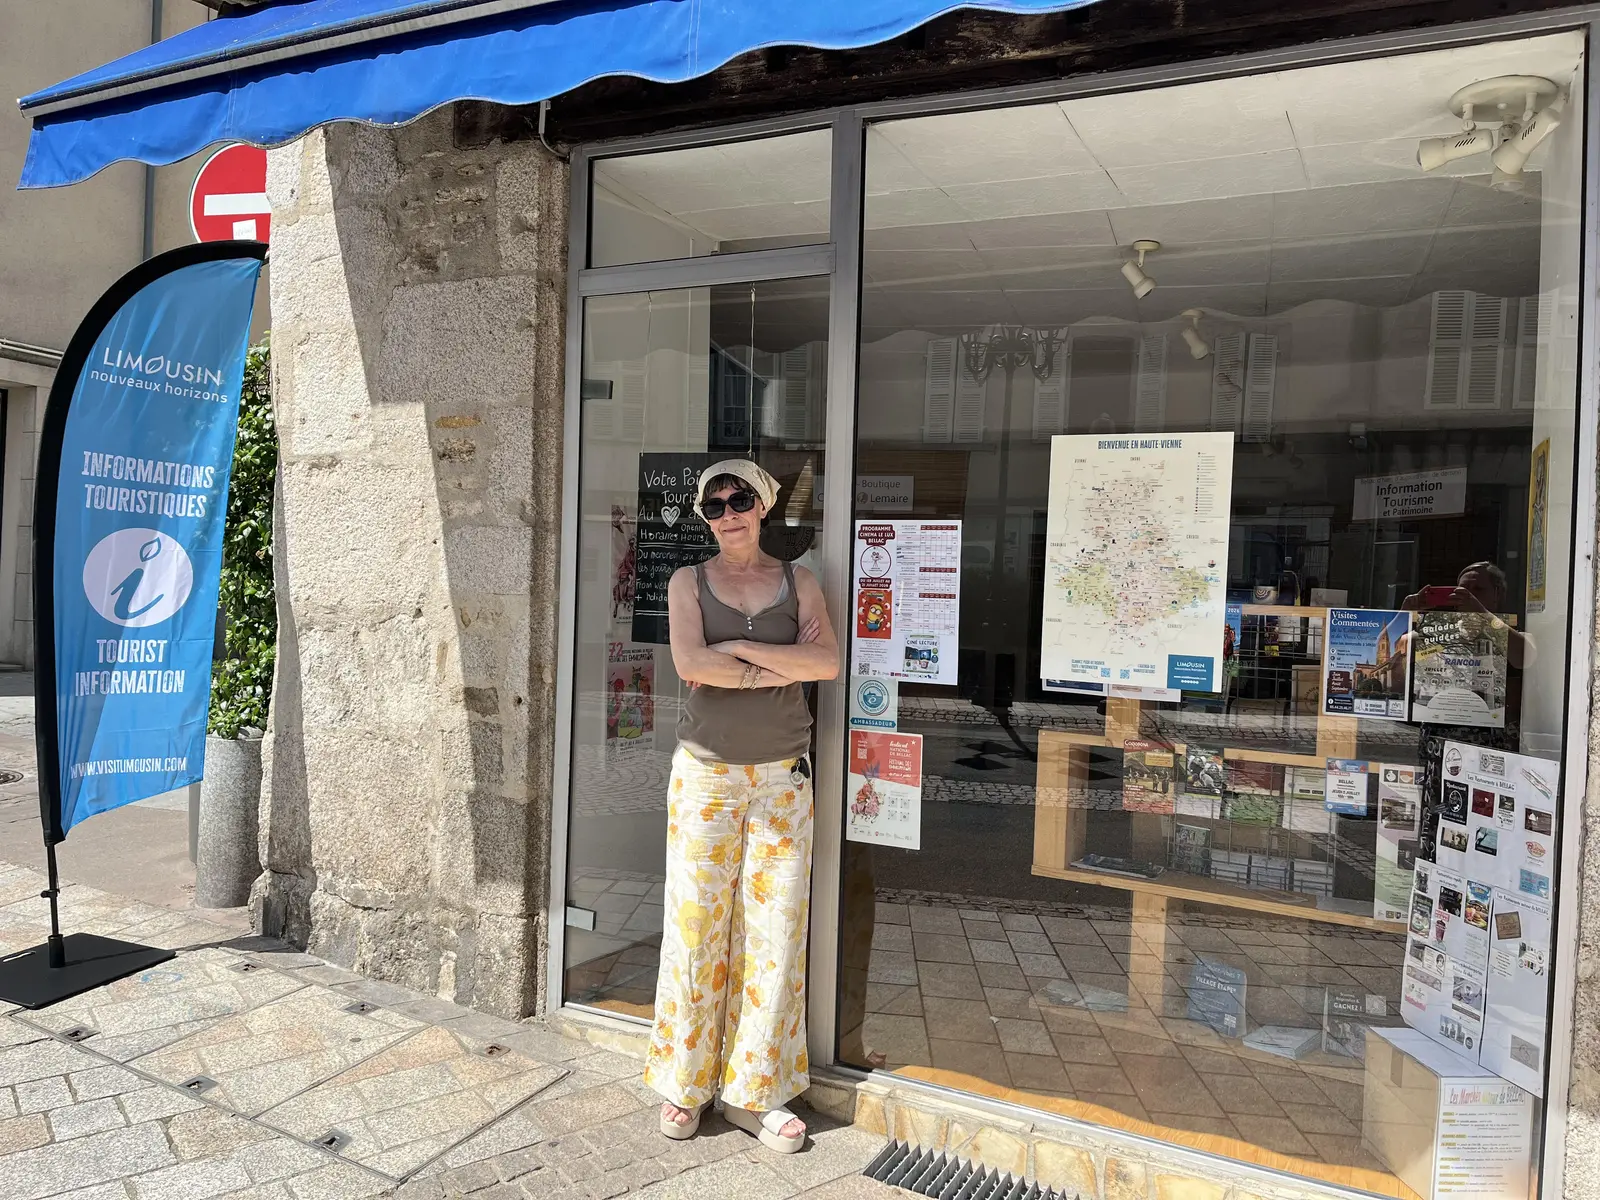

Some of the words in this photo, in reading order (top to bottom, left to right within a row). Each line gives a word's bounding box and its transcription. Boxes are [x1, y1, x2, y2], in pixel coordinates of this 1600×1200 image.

[103, 347, 222, 387] LIMOUSIN
[91, 370, 161, 392] nouveaux
[165, 382, 228, 403] horizons
[1098, 440, 1130, 449] BIENVENUE
[1131, 440, 1139, 449] EN
[1140, 439, 1182, 449] HAUTE-VIENNE
[81, 450, 215, 488] INFORMATIONS
[643, 469, 677, 488] Votre
[862, 480, 901, 492] Boutique
[1376, 481, 1443, 496] Information
[84, 484, 207, 518] TOURISTIQUES
[870, 494, 909, 503] Lemaire
[1383, 494, 1434, 508] Tourisme
[638, 505, 654, 521] Au
[1383, 508, 1390, 517] et
[1392, 506, 1433, 516] Patrimoine
[640, 528, 678, 540] Horaires
[637, 548, 648, 560] Du
[1332, 611, 1358, 620] Visites
[1331, 619, 1380, 628] Commentées
[1422, 623, 1460, 634] Balades
[1424, 633, 1460, 645] guidées
[96, 639, 168, 663] TOURIST
[608, 642, 623, 656] 72
[1444, 658, 1481, 667] RANCON
[75, 669, 186, 697] INFORMATION
[853, 719, 893, 727] AMBASSADEUR
[70, 757, 187, 779] WWW.VISITLIMOUSIN.COM
[1195, 975, 1216, 987] VILLAGE
[1333, 1002, 1358, 1011] GAGNEZ
